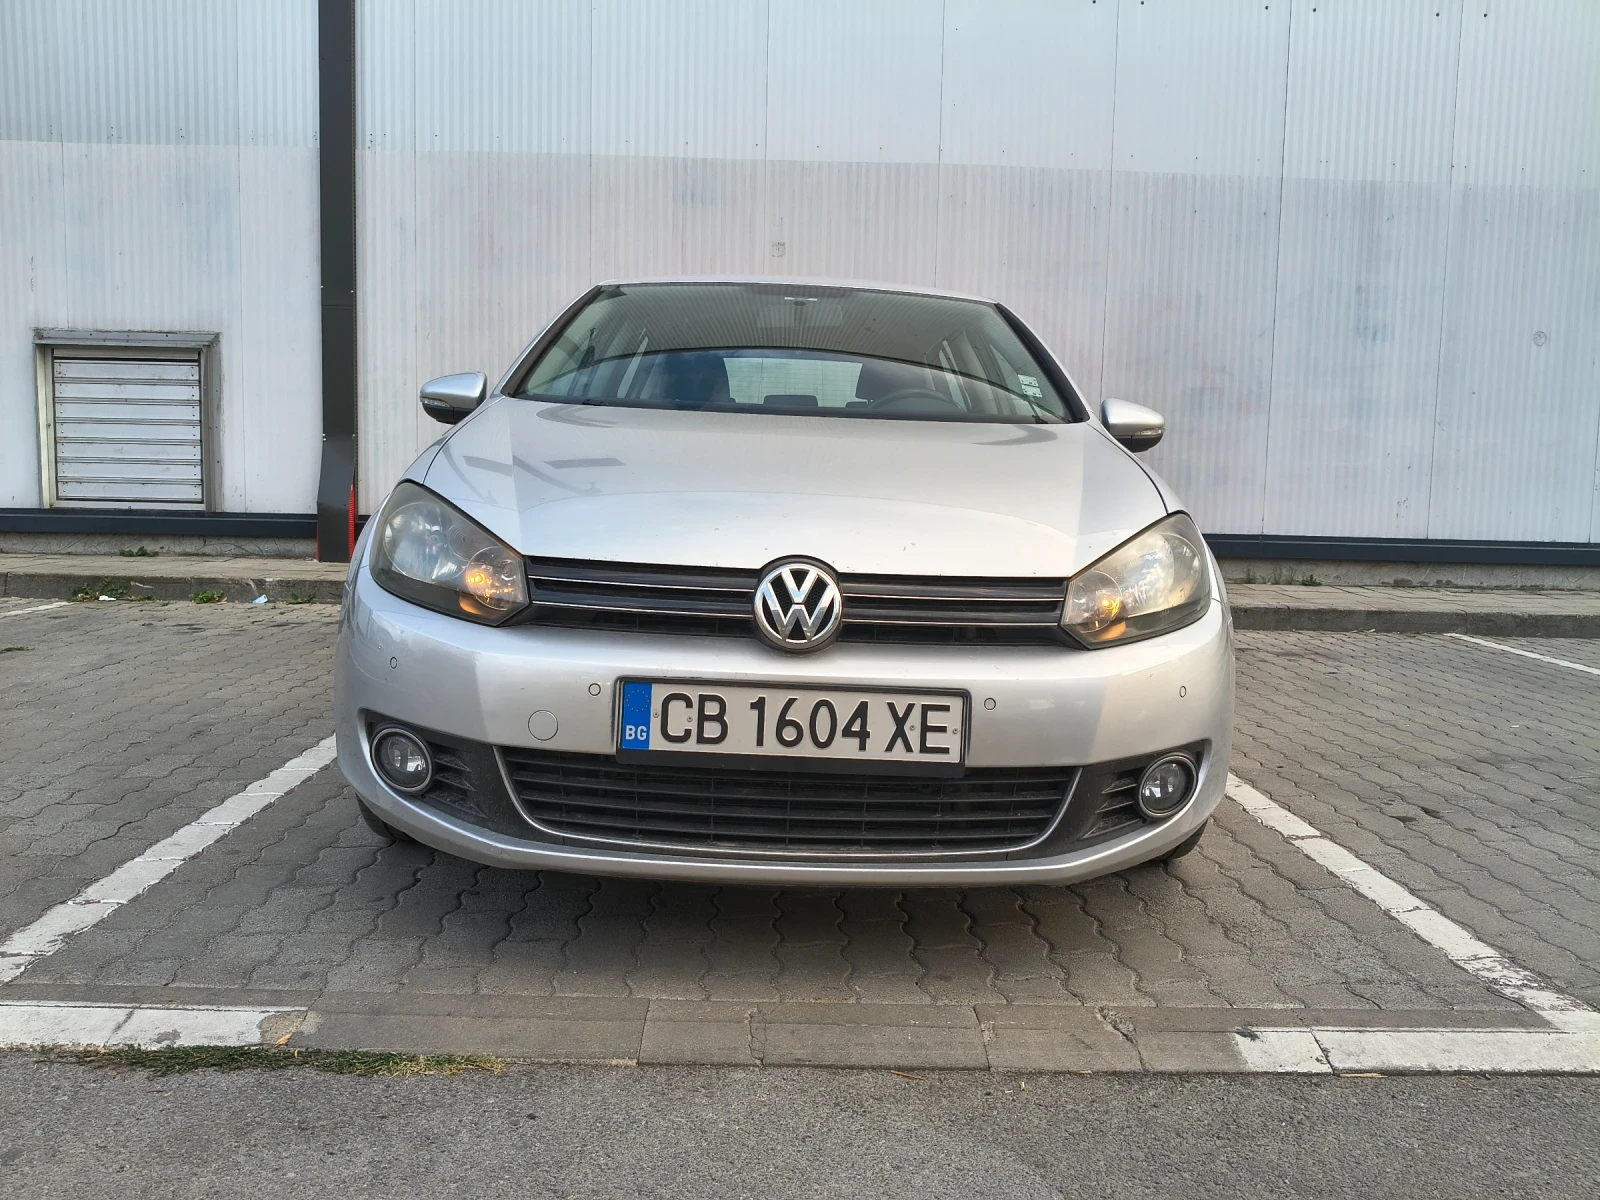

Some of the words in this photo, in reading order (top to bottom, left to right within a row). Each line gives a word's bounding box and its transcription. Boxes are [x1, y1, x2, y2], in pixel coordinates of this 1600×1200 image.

[757, 564, 839, 643] VW
[625, 725, 648, 741] BG
[660, 692, 729, 745] CB
[750, 695, 871, 751] 1604
[884, 701, 951, 754] XE
